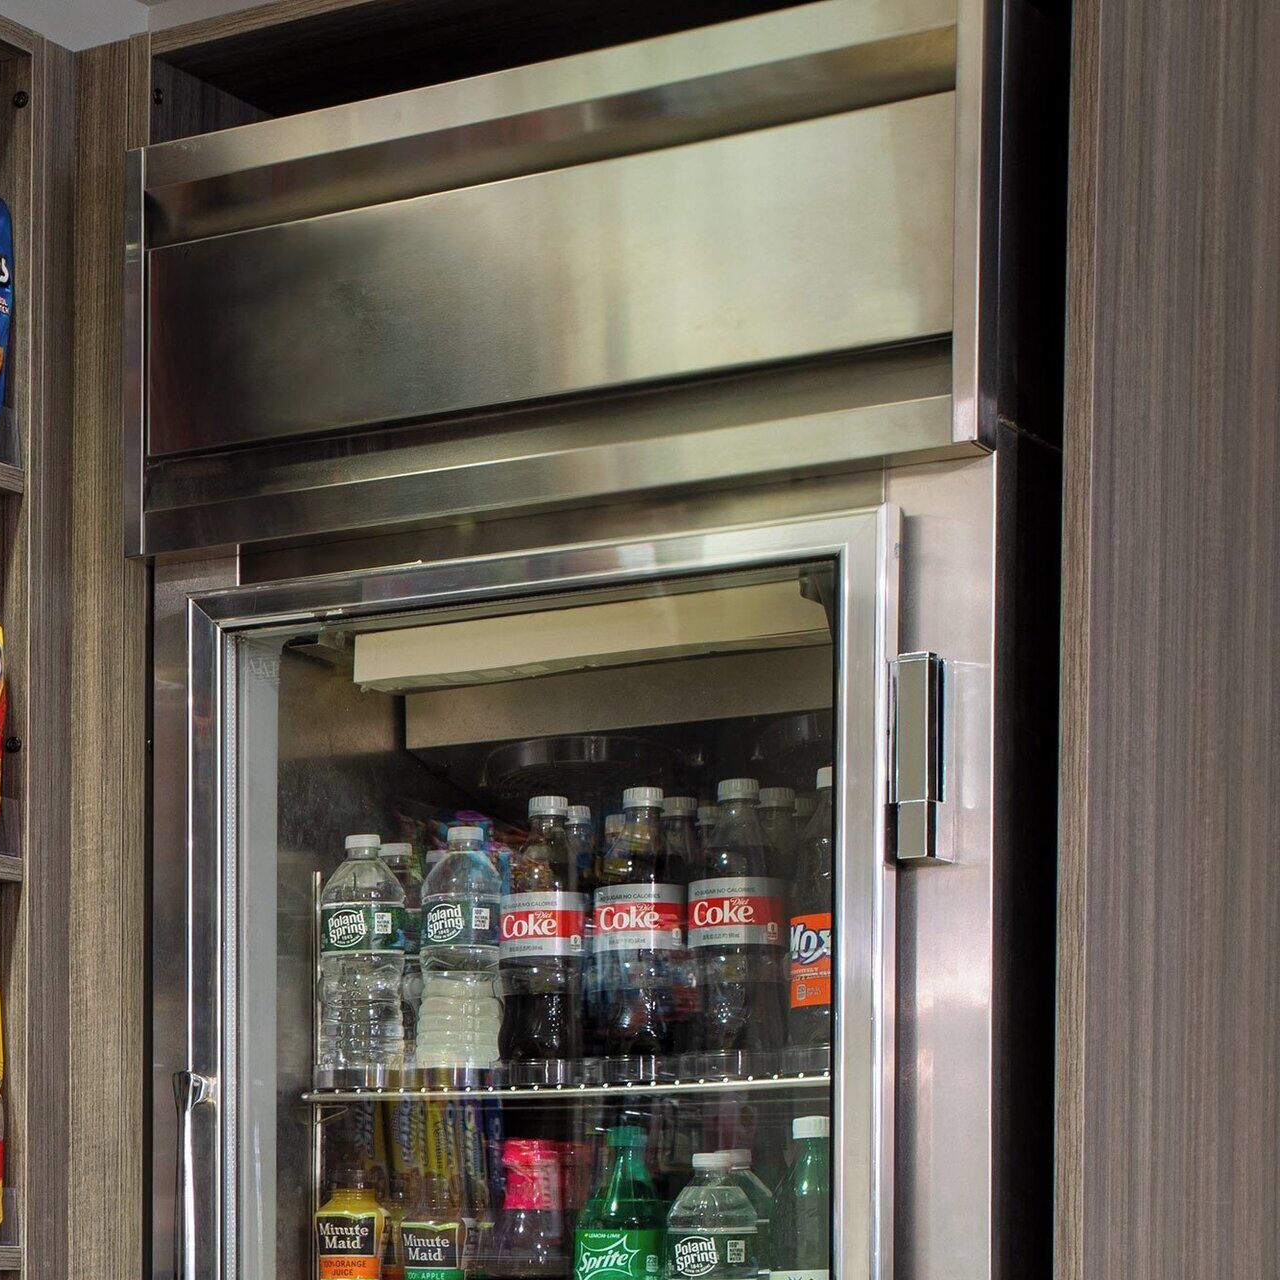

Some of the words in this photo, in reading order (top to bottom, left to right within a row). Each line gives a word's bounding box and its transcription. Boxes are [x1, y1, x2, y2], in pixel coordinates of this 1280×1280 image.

[329, 910, 364, 929] Poland
[427, 905, 462, 923] Poland
[599, 907, 660, 931] Coke
[693, 901, 754, 925] Coke
[328, 923, 366, 938] Spring
[427, 917, 464, 935] Spring
[503, 914, 557, 937] Coke
[319, 1223, 369, 1238] Minute
[325, 1236, 362, 1249] Maid
[582, 1253, 630, 1273] Sprite
